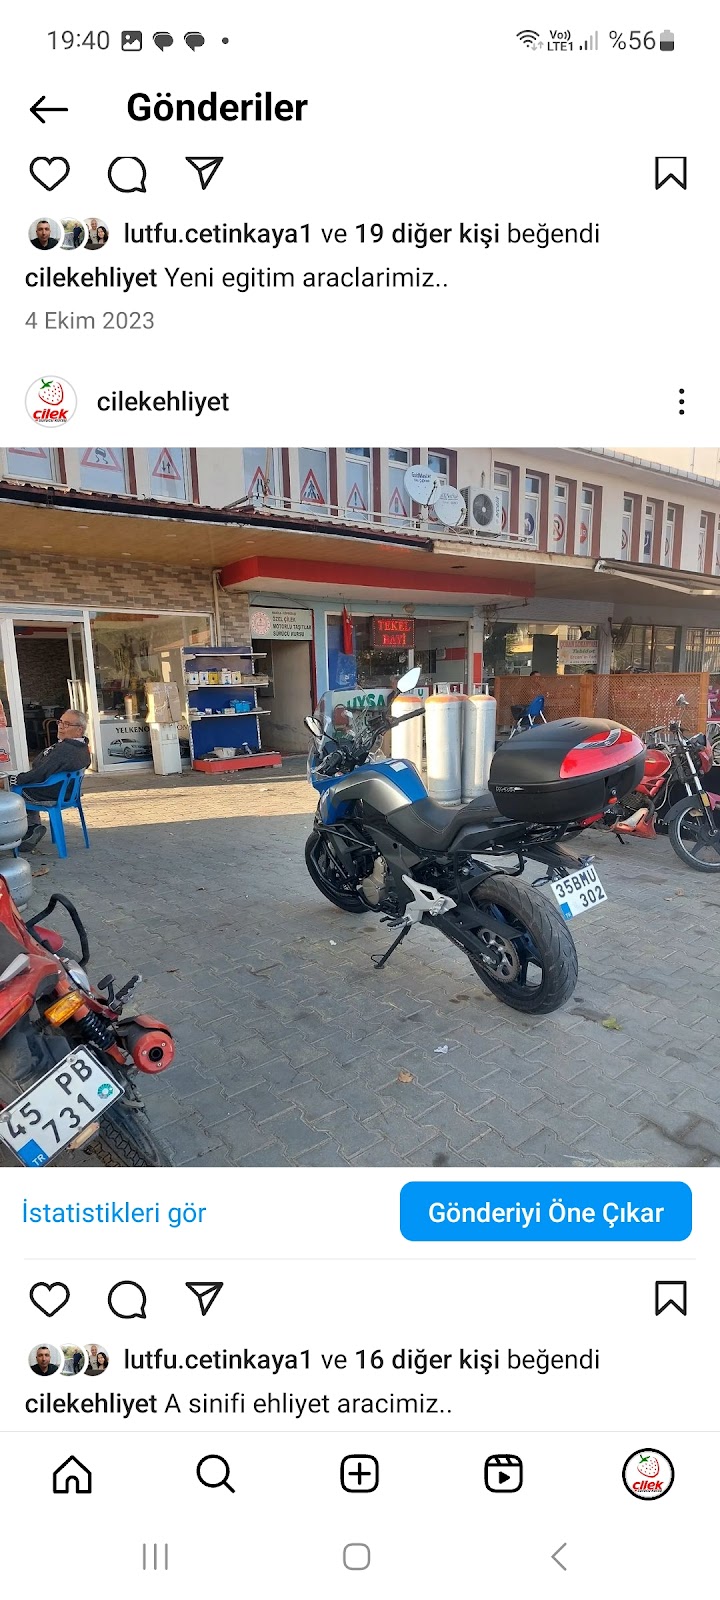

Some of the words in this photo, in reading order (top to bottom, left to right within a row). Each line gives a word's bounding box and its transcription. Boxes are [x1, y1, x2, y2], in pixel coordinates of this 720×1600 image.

[377, 620, 411, 632] TEKEL
[555, 868, 597, 898] 35BMU
[579, 885, 605, 907] 302
[6, 1101, 42, 1139] 45
[54, 1059, 93, 1096] PB
[41, 1093, 96, 1144] 731
[31, 1153, 46, 1166] TR
